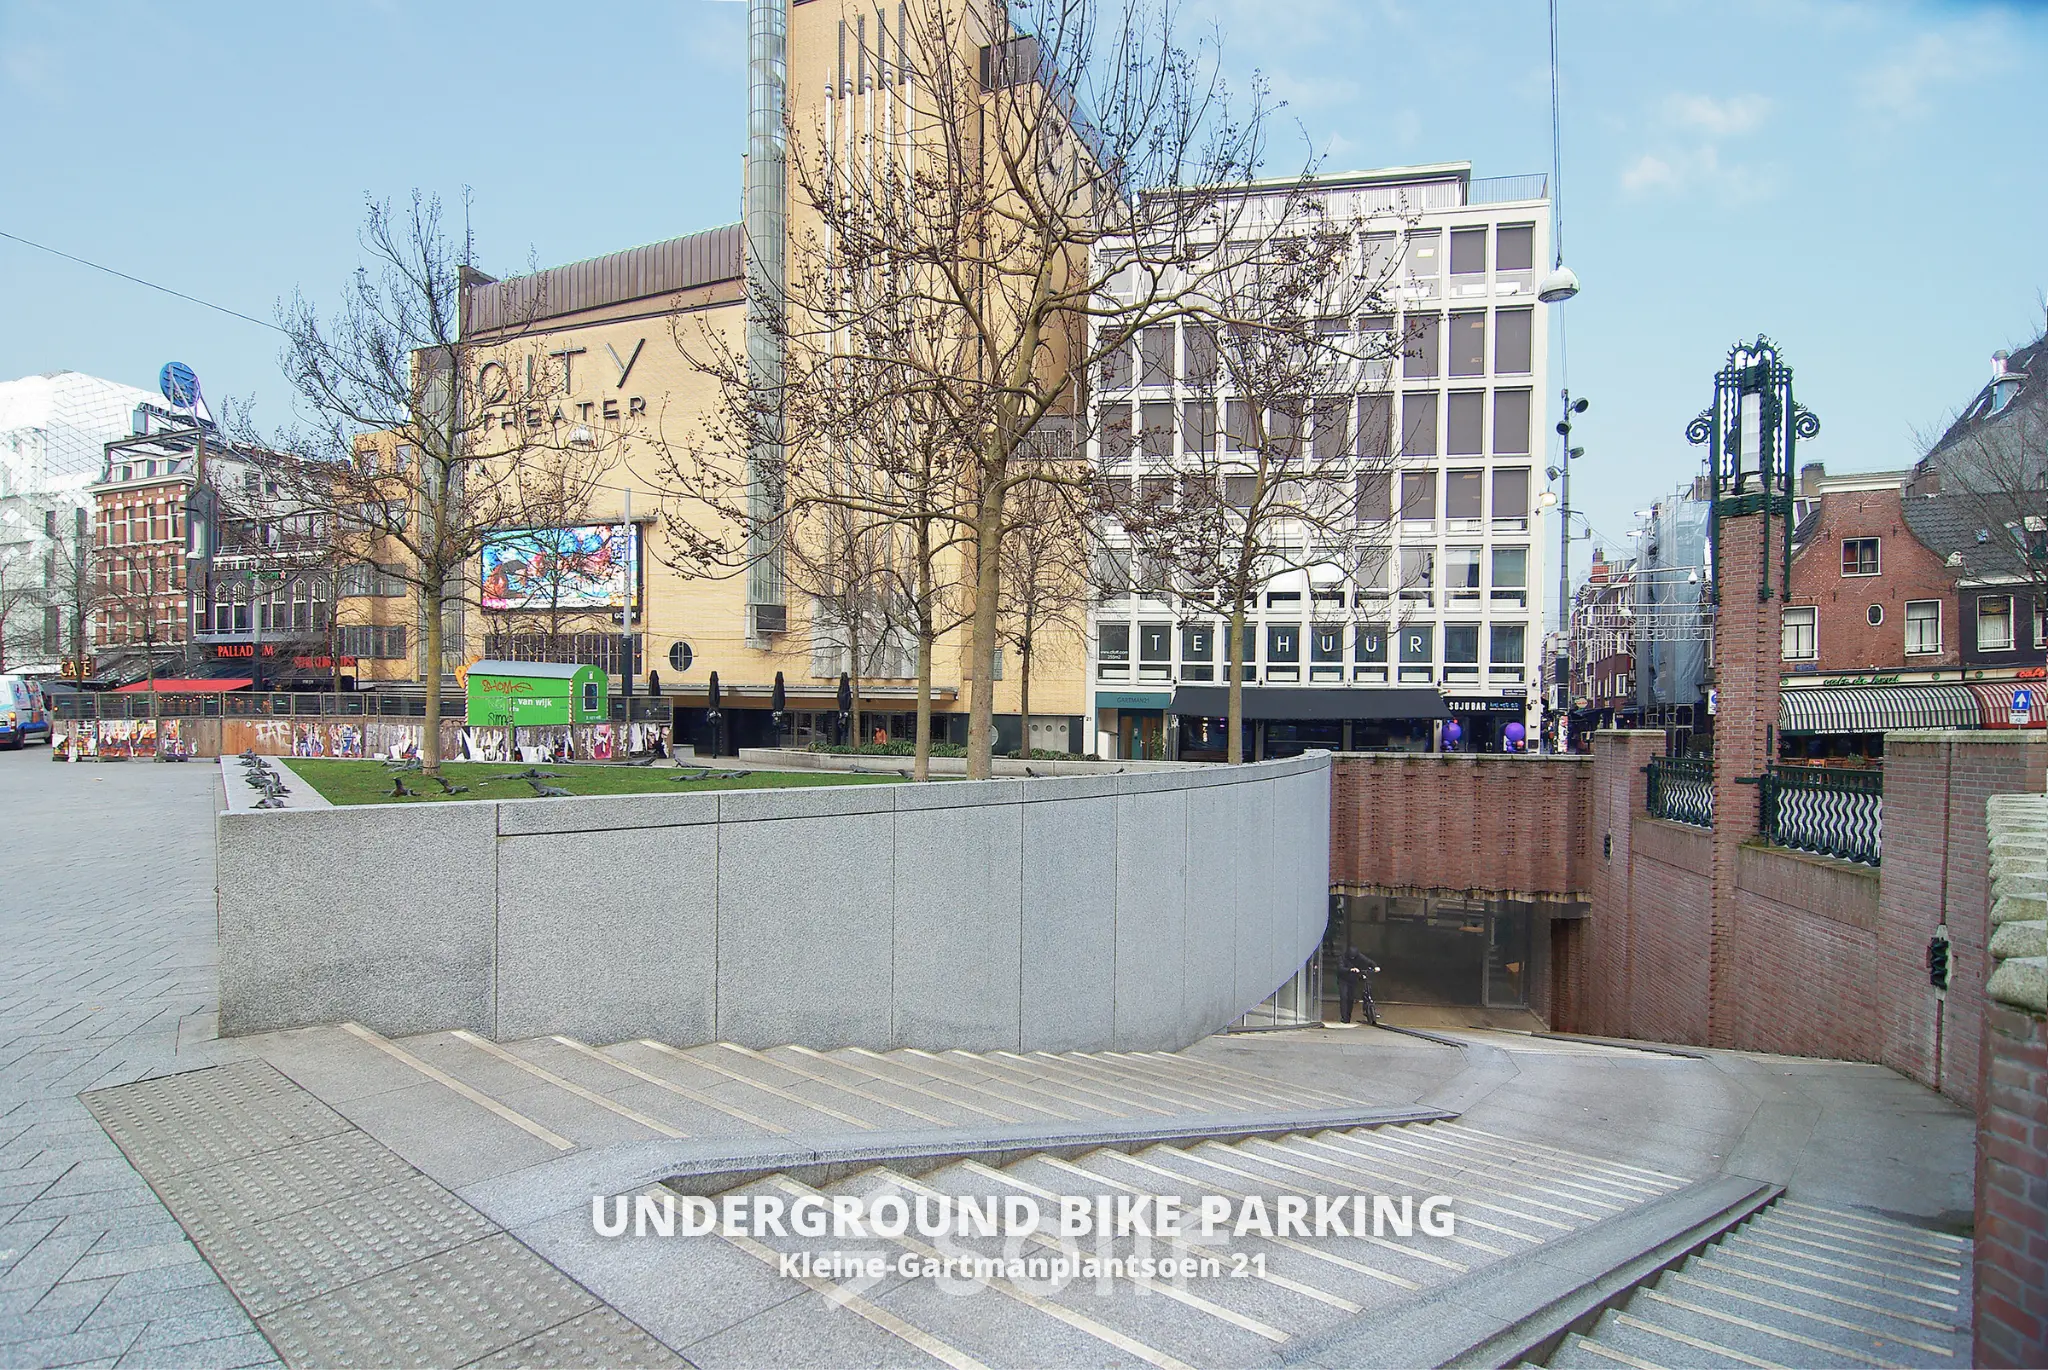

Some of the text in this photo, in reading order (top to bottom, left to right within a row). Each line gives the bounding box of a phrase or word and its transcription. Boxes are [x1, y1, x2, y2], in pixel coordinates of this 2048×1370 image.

[477, 338, 646, 402] CITY
[482, 395, 647, 431] THEATER
[217, 645, 274, 658] PALLADM
[1277, 636, 1422, 652] HUUR
